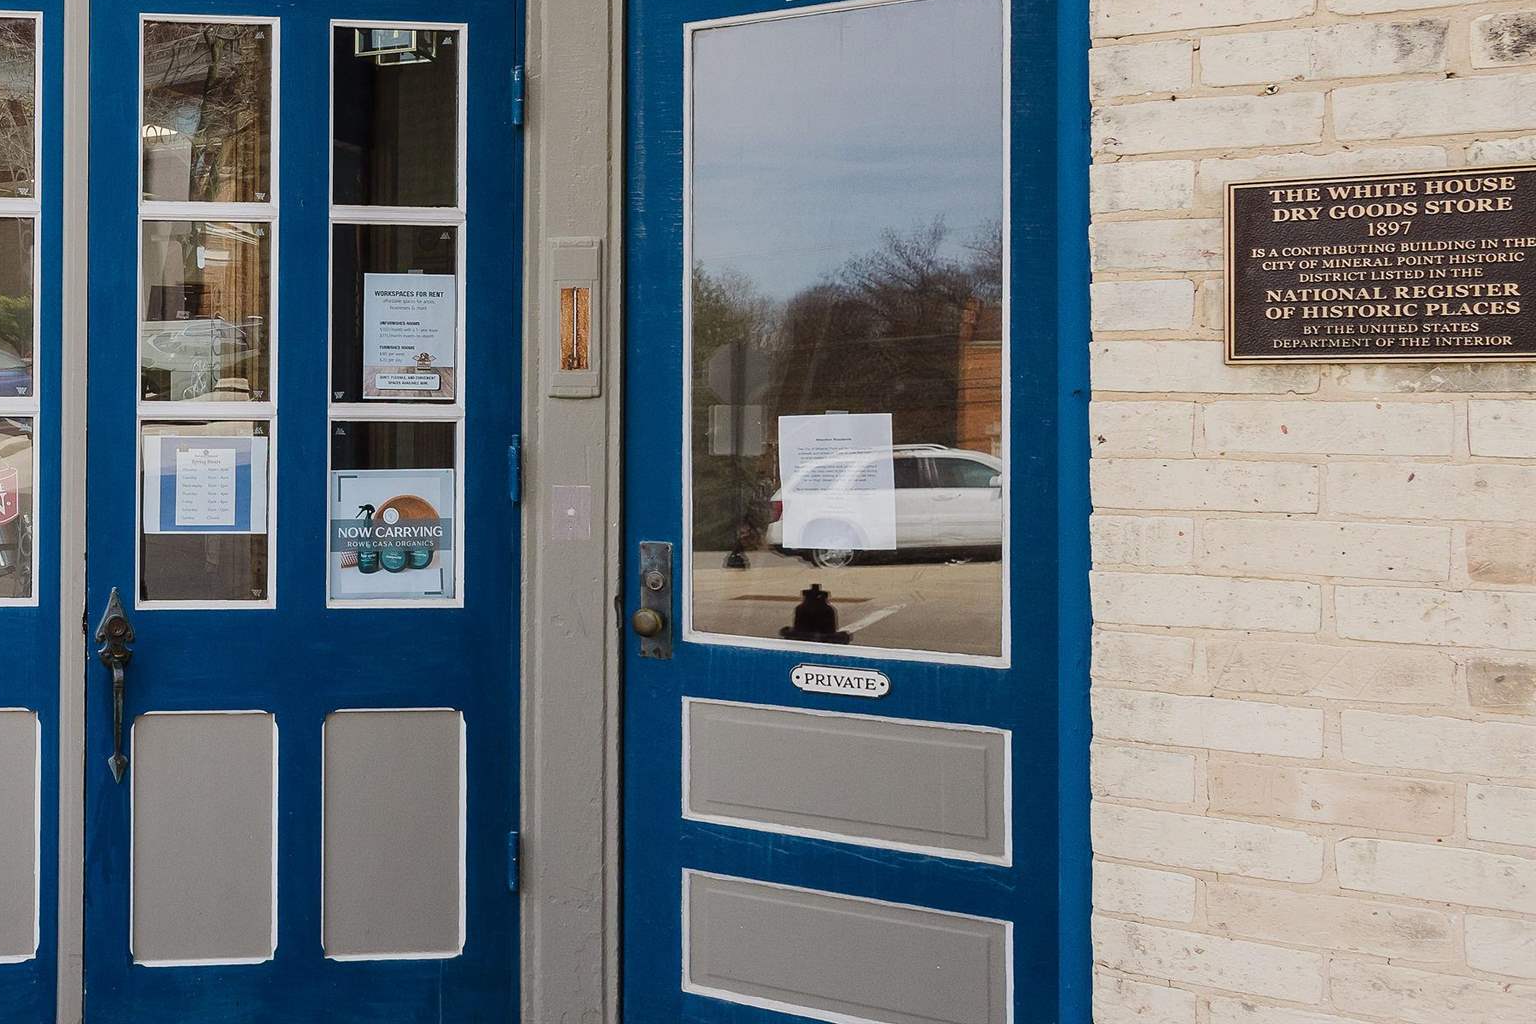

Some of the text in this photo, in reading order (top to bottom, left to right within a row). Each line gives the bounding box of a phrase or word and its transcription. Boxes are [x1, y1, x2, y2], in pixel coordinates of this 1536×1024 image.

[1269, 176, 1516, 203] THE WHITE HOUSE
[1272, 197, 1513, 222] DRY GOODS STORE
[1367, 221, 1411, 237] 1897
[1251, 237, 1536, 258] IS A CONTRIBUTING BUILDING IN THE
[1262, 252, 1525, 271] CITY OF MINERAL POINT HISTORIC
[1299, 267, 1484, 283] DISTRICT LISTED IN THE
[1265, 283, 1521, 303] NATIONAL REGISTER
[1265, 301, 1521, 320] OF HISTORIC PLACES
[1303, 322, 1479, 335] BY THE UNITED STATES
[1273, 336, 1513, 349] DEPARTMENT OF THE INTERIOR
[338, 525, 443, 538] NOW CARRYING
[372, 540, 393, 548] CASA
[804, 672, 876, 691] PRIVATE
